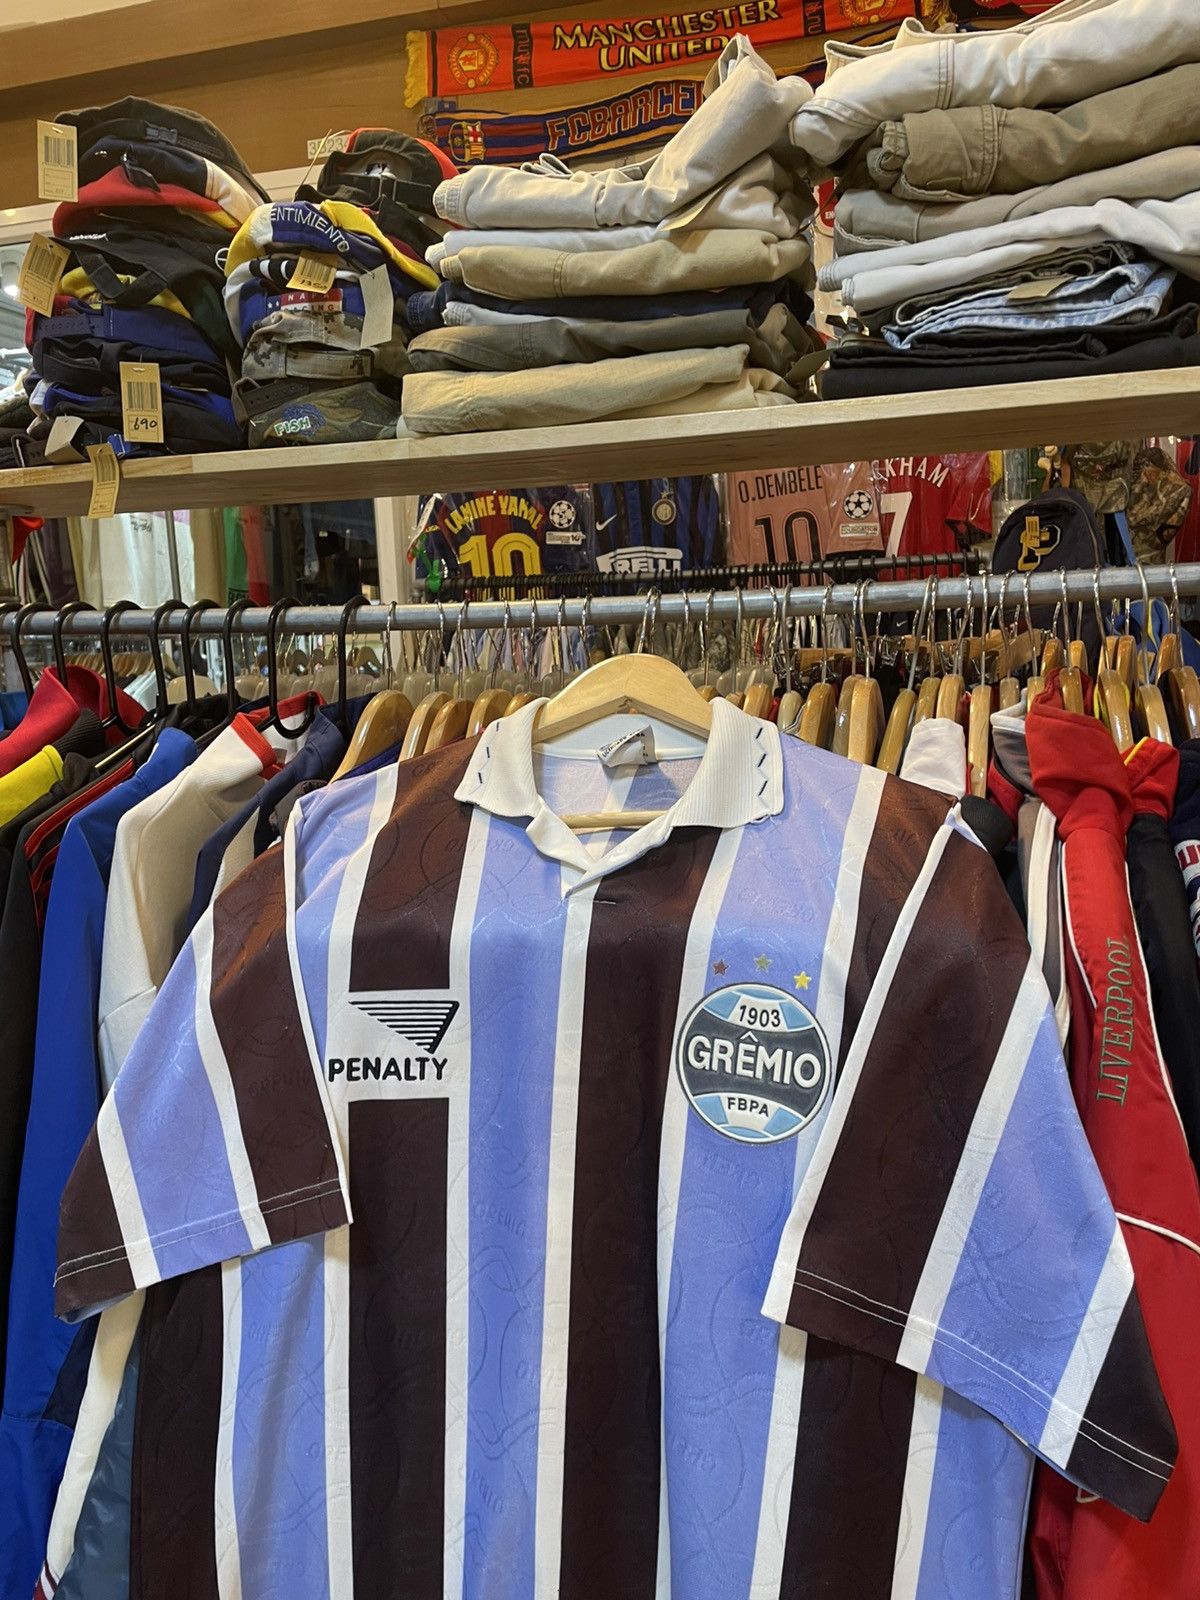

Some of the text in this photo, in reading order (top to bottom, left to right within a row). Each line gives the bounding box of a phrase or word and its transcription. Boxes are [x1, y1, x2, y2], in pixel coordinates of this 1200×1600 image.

[553, 0, 781, 50] MANCHESTER
[599, 34, 731, 71] UNITED
[133, 416, 158, 430] 690
[274, 416, 311, 437] FISH
[444, 495, 543, 534] LAMINE YAMAL
[880, 491, 913, 558] 7
[459, 532, 542, 588] 10
[755, 510, 822, 578] 10
[739, 1004, 781, 1027] 1903
[1096, 936, 1134, 1107] LIVERPOOL
[328, 1057, 448, 1082] PENALTY
[687, 1031, 822, 1089] GRÊMIO
[727, 1097, 769, 1117] FBPA
